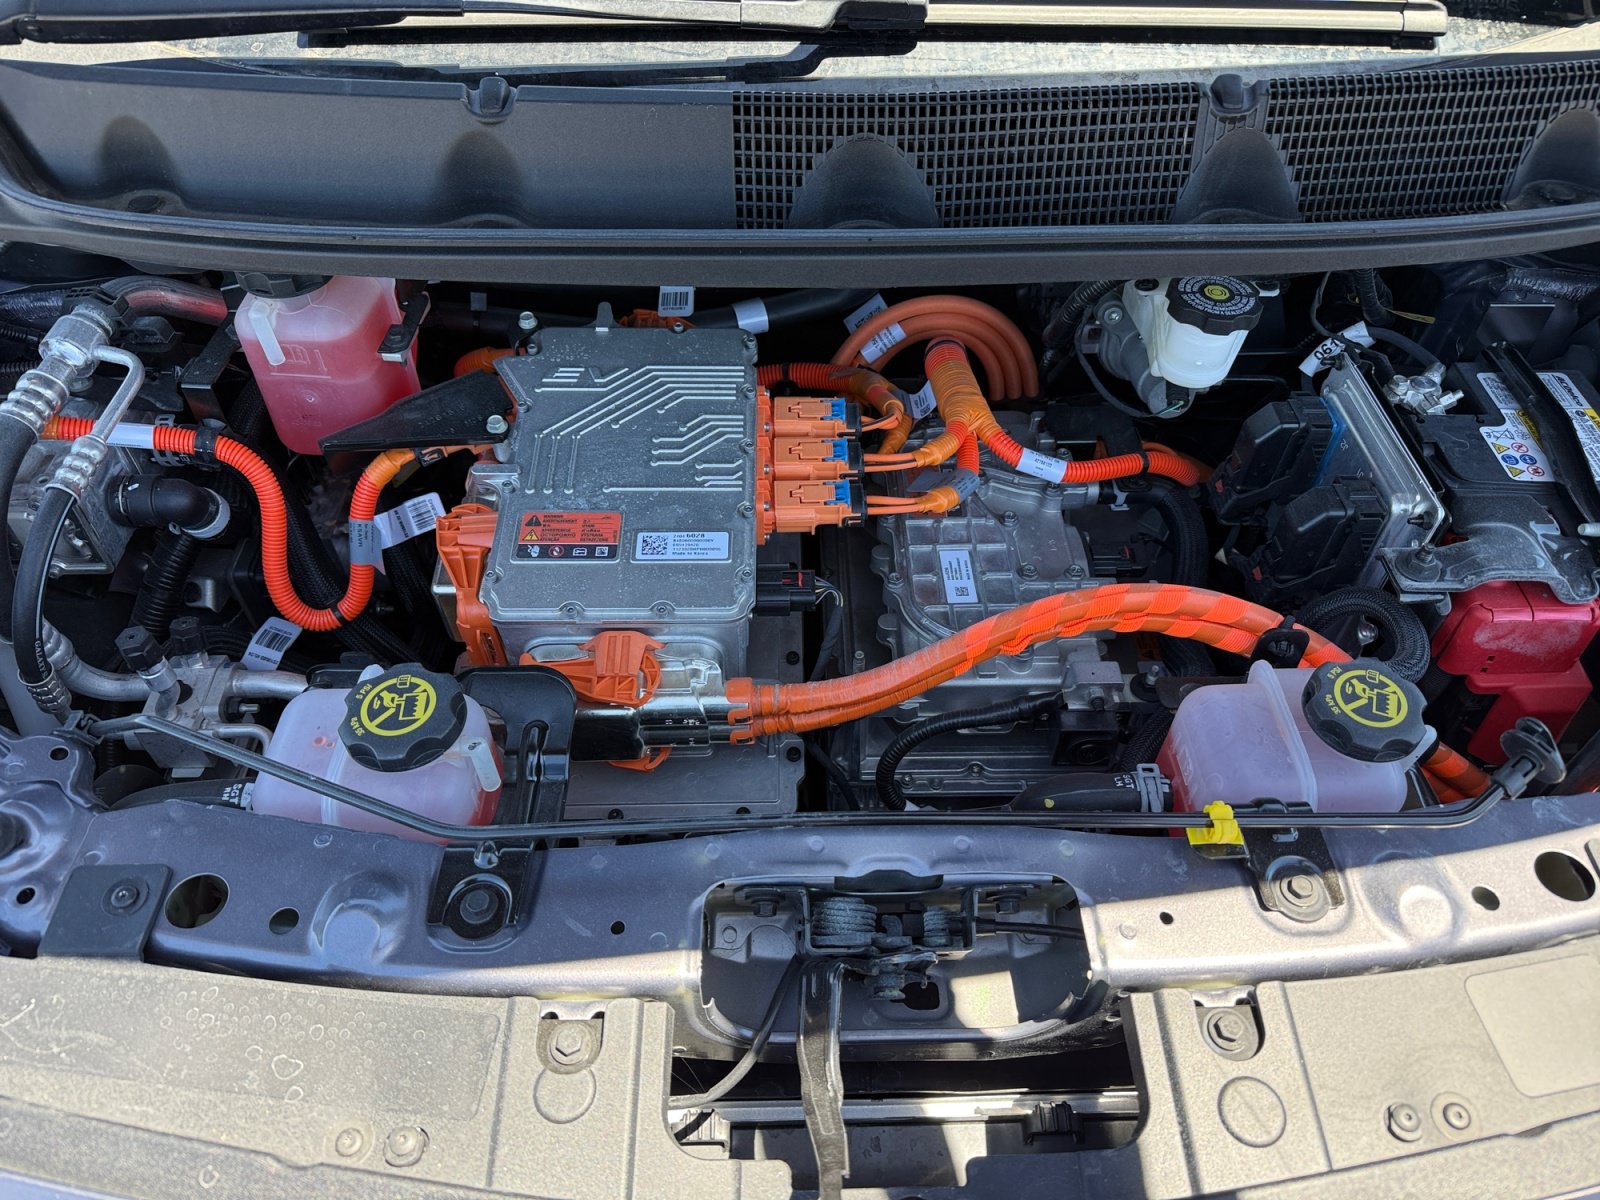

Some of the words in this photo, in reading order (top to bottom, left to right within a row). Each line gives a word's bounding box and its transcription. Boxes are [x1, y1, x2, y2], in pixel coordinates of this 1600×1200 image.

[35, 640, 46, 671] GALAXY
[1114, 776, 1124, 787] LH
[1122, 774, 1134, 789] SGT
[221, 786, 232, 801] RH
[229, 784, 243, 805] SGT
